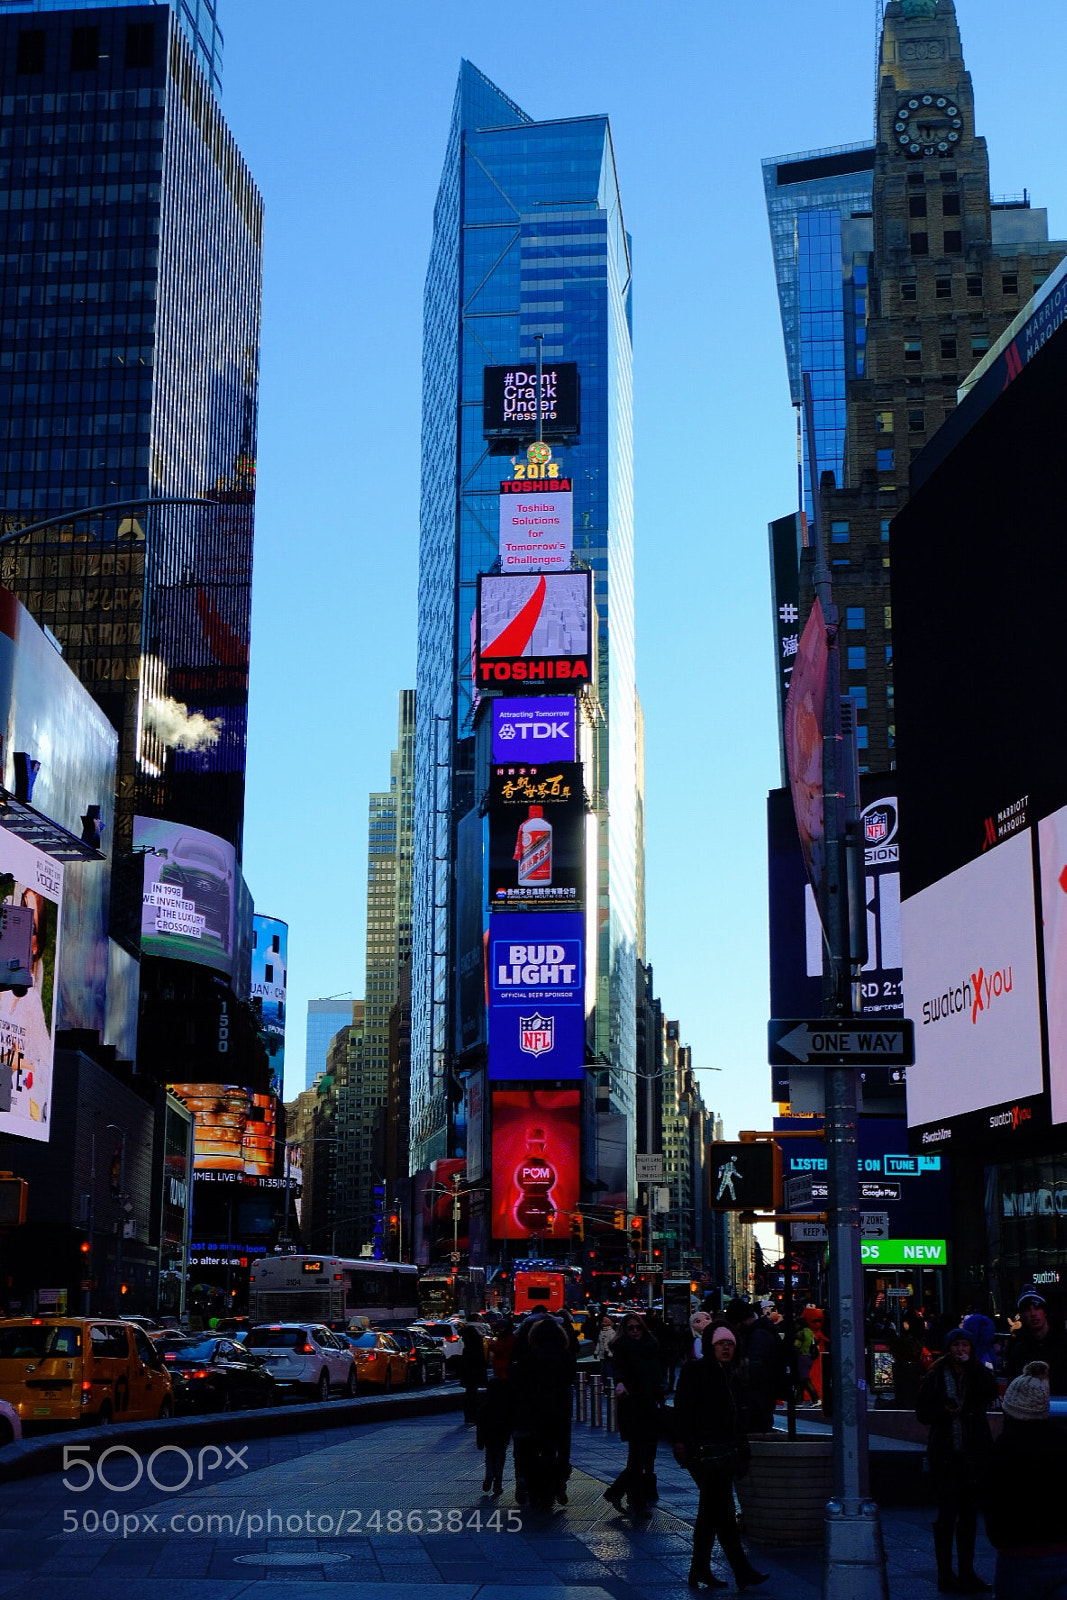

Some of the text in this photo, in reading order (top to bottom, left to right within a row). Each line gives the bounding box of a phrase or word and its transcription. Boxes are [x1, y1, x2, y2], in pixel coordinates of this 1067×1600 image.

[504, 398, 557, 411] Under
[514, 464, 559, 479] 2018
[501, 479, 570, 492] TOSHIBA
[517, 504, 555, 512] Toshiba
[512, 517, 560, 525] Solutions
[505, 542, 566, 551] Tomorrow's
[506, 555, 565, 564] Challenges.
[479, 660, 588, 680] TOSHIBA
[499, 711, 533, 719] Attracting
[515, 722, 570, 738] TDK
[997, 795, 1029, 823] MARRIOTT
[867, 825, 885, 838] NFL
[998, 812, 1026, 837] MARQUIS
[152, 884, 181, 897] IN 1998
[143, 895, 194, 911] WE INVENTED
[162, 909, 205, 924] THE LUXURY
[156, 920, 201, 936] CROSSOVER
[509, 945, 565, 965] BUD
[498, 964, 576, 985] LIGHT
[217, 1001, 229, 1053] 1500
[523, 1032, 549, 1050] NFL
[812, 1034, 897, 1052] ONE WAY
[864, 1159, 880, 1171] ON
[889, 1160, 915, 1170] TUNE
[862, 1189, 898, 1198] Google Play
[866, 1216, 885, 1225] ZONE
[903, 1245, 941, 1259] NEW
